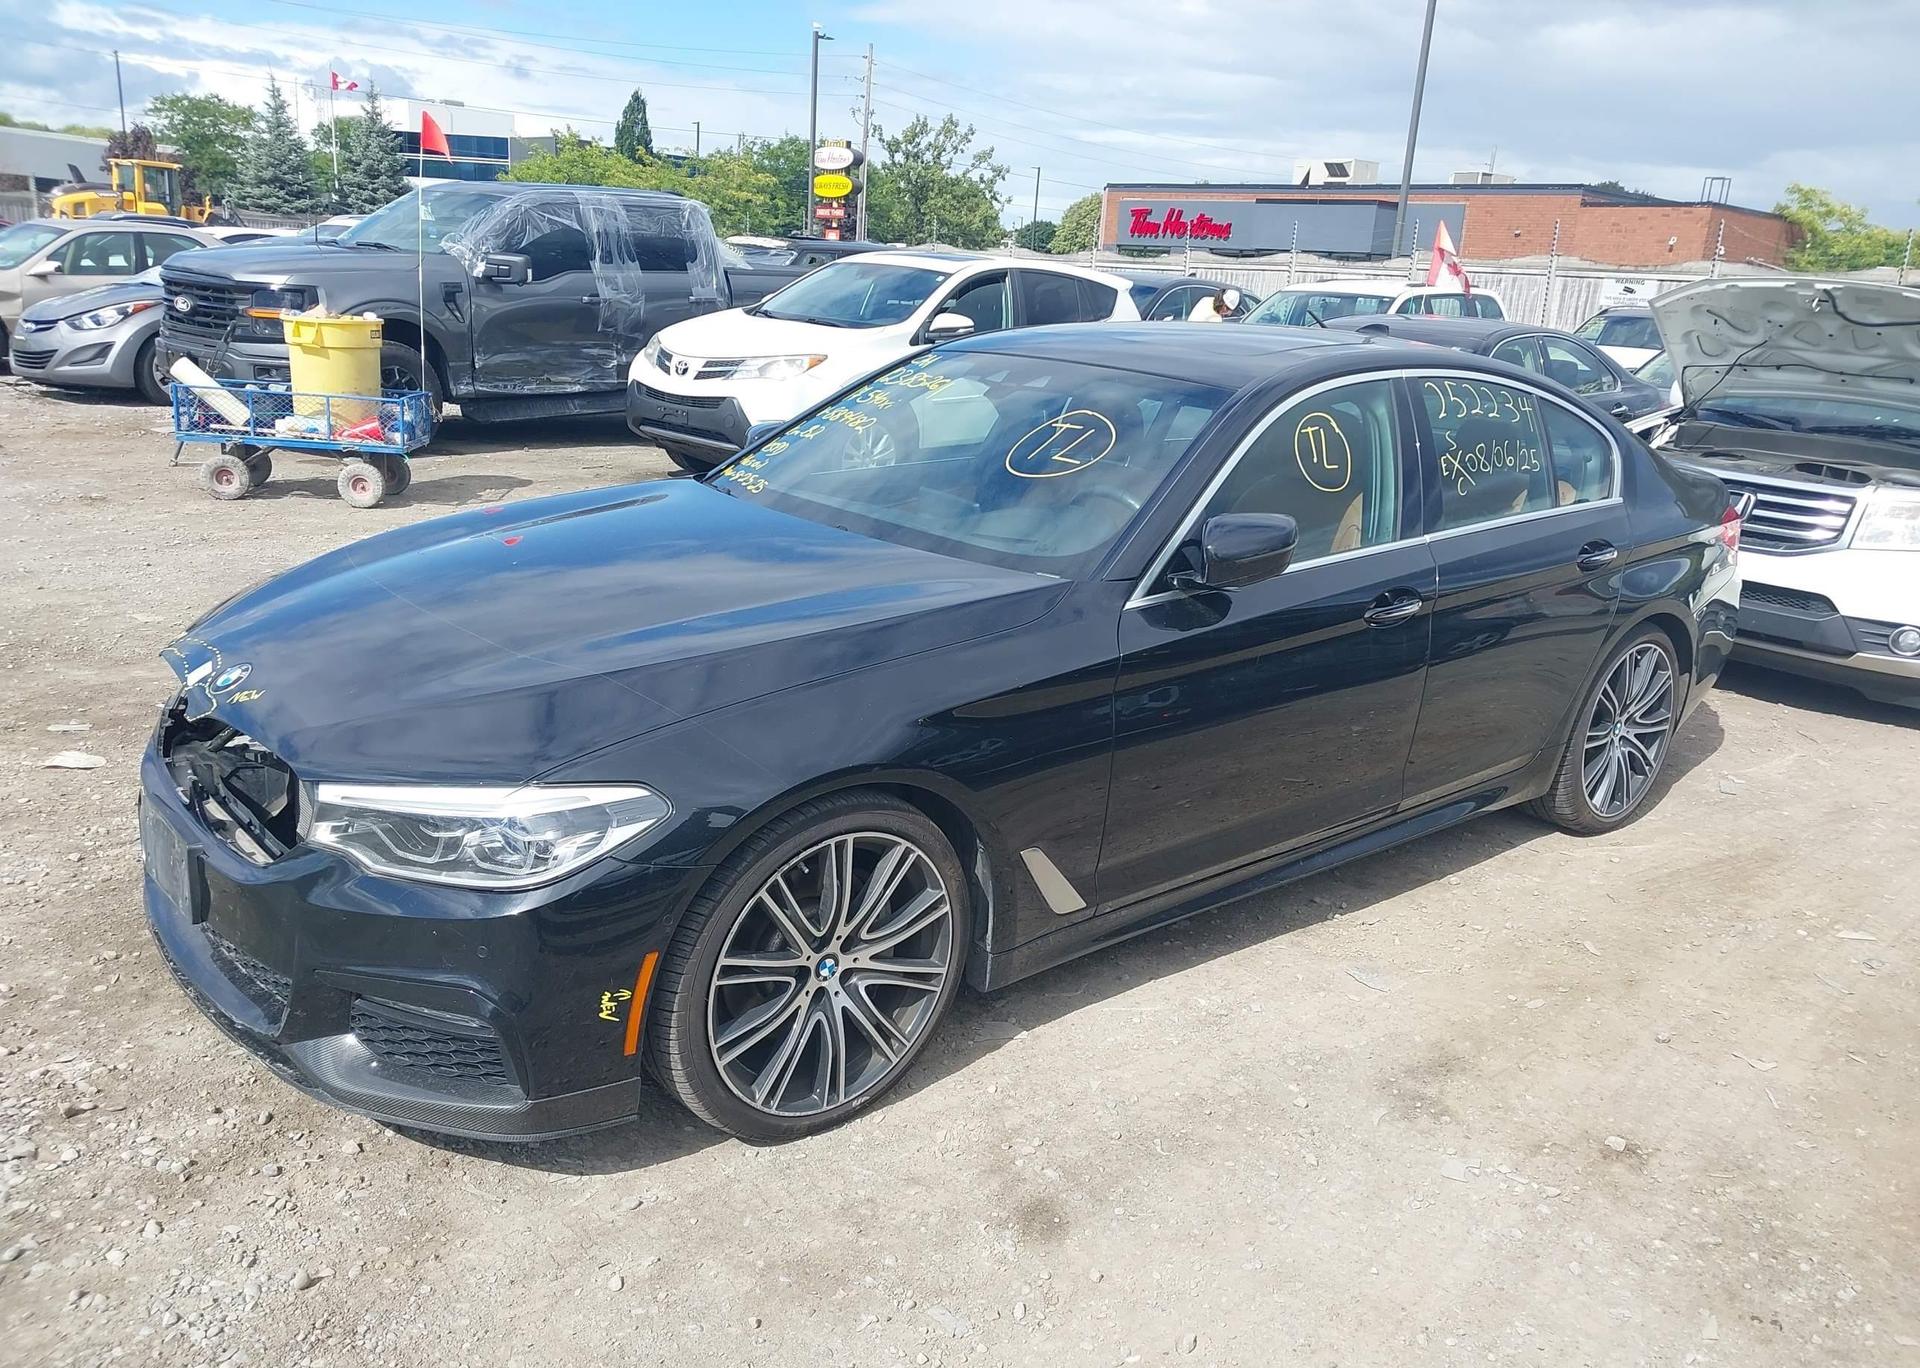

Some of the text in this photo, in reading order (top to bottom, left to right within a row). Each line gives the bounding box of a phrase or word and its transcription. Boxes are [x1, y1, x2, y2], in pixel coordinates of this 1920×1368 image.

[1130, 207, 1161, 238] Tim
[1423, 380, 1534, 433] 252234
[1464, 439, 1541, 476] 08/06/25
[225, 689, 267, 705] NEW
[598, 990, 621, 1023] NEW
